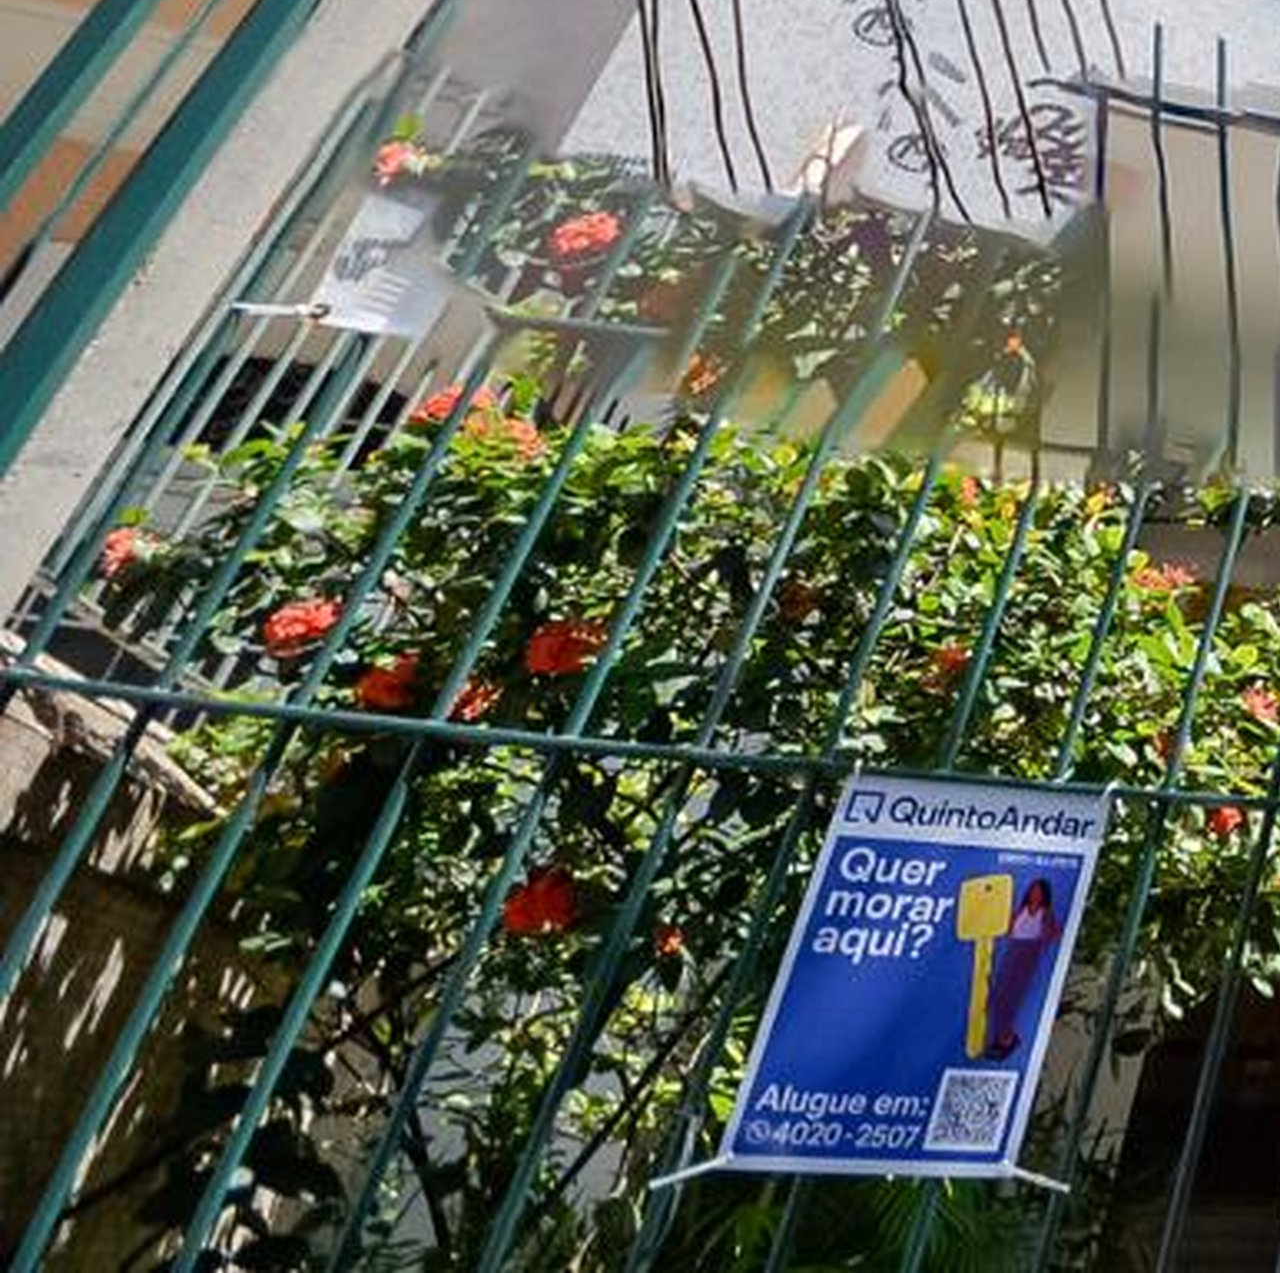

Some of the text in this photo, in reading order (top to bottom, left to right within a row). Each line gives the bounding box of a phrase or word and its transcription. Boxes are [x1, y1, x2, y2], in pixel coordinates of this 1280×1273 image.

[890, 796, 1095, 838] QuintoAndar
[840, 846, 947, 886] Quer
[825, 890, 955, 923] morar
[812, 923, 934, 965] aqui?
[755, 1083, 930, 1121] Alugue em:
